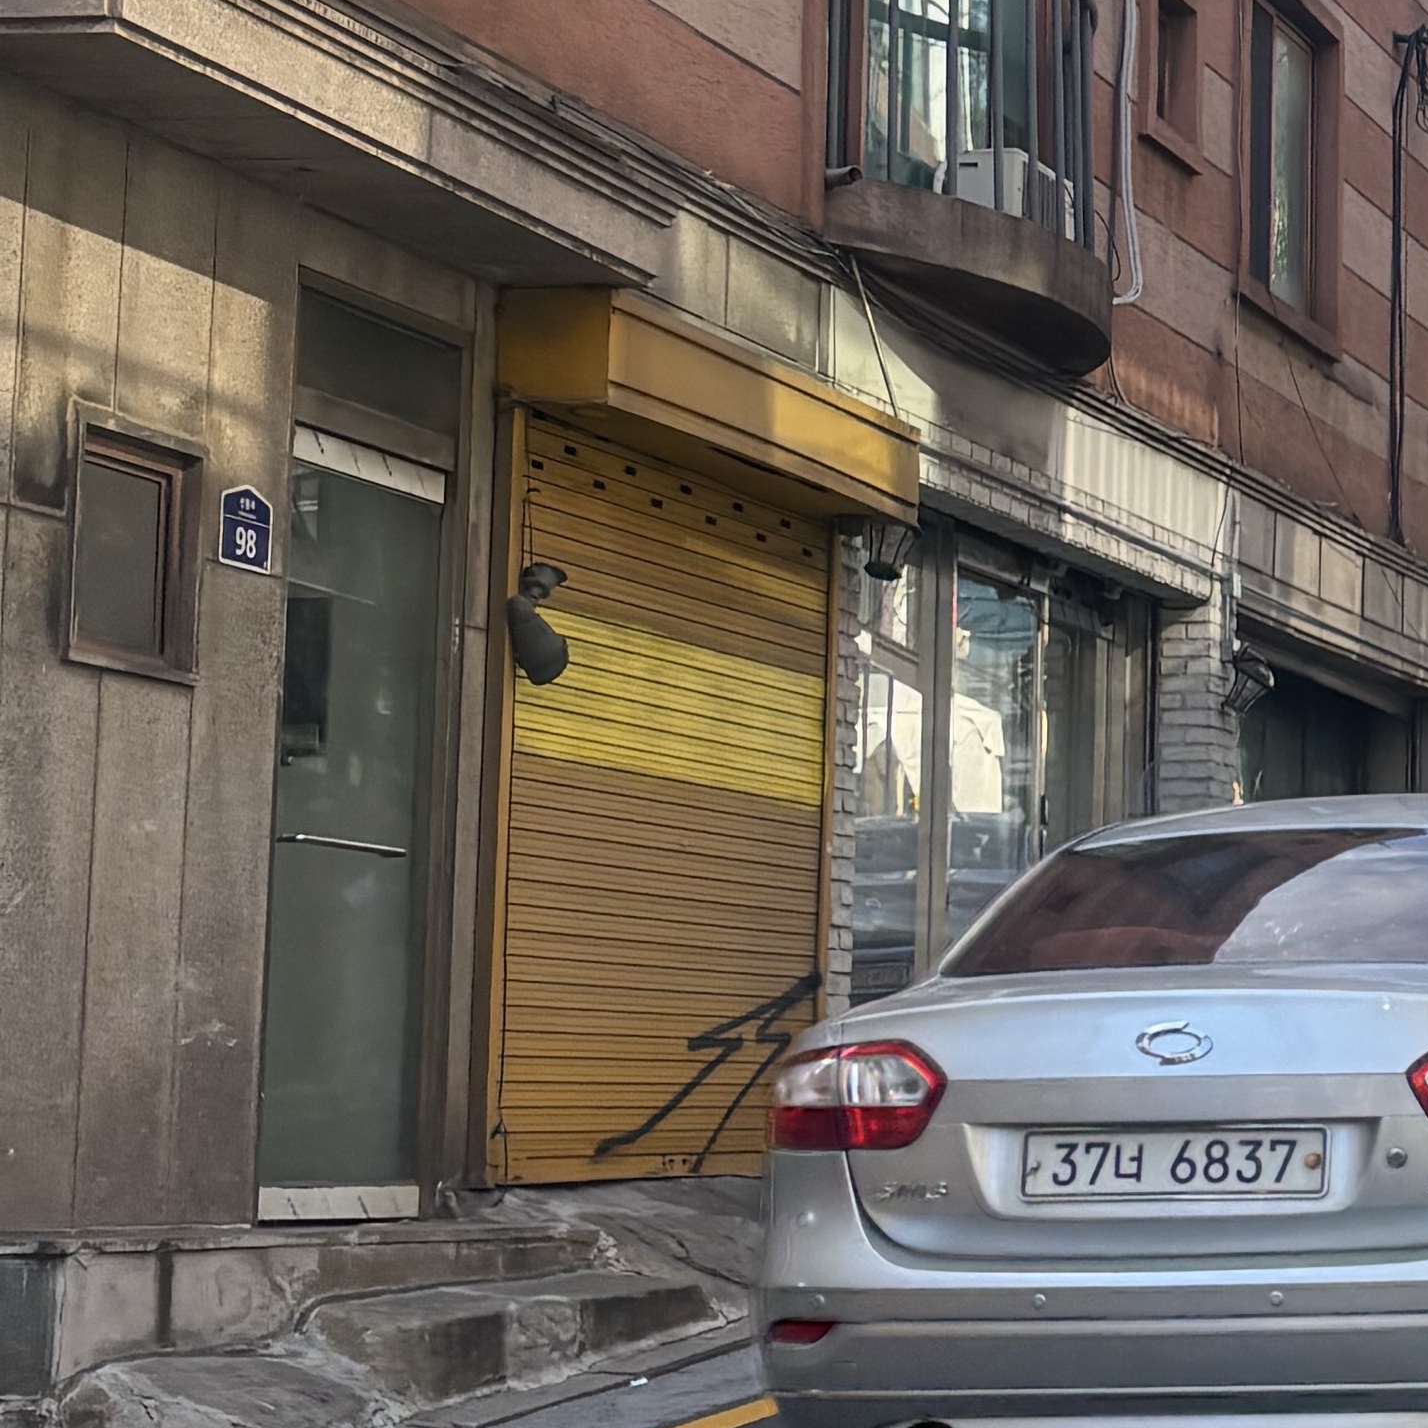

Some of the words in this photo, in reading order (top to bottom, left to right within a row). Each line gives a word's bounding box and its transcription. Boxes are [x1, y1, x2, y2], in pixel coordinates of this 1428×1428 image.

[235, 526, 257, 559] 98
[1051, 1140, 1143, 1188] 37너
[1169, 1139, 1299, 1186] 6837
